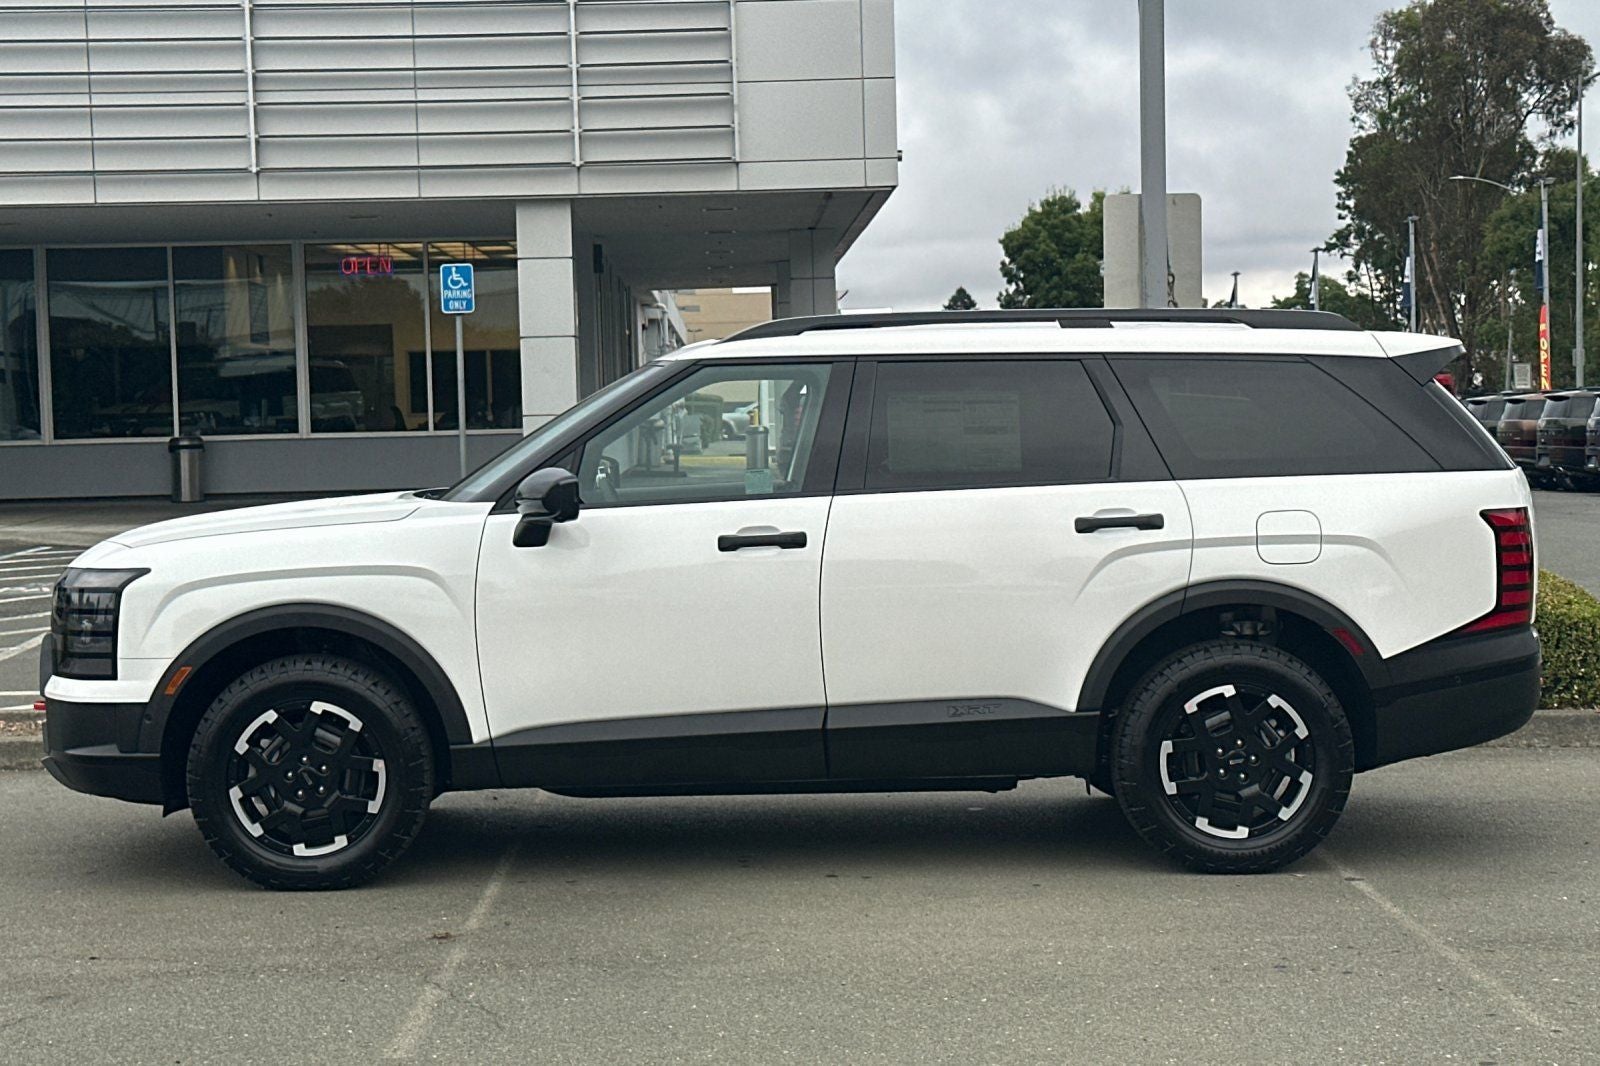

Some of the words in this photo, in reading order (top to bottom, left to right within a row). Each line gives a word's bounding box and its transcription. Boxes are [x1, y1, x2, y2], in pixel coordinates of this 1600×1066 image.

[341, 256, 392, 275] OPEN
[443, 289, 472, 299] PARKING
[449, 300, 467, 310] ONLY
[1540, 338, 1550, 390] OPEN
[946, 703, 1002, 718] XRT
